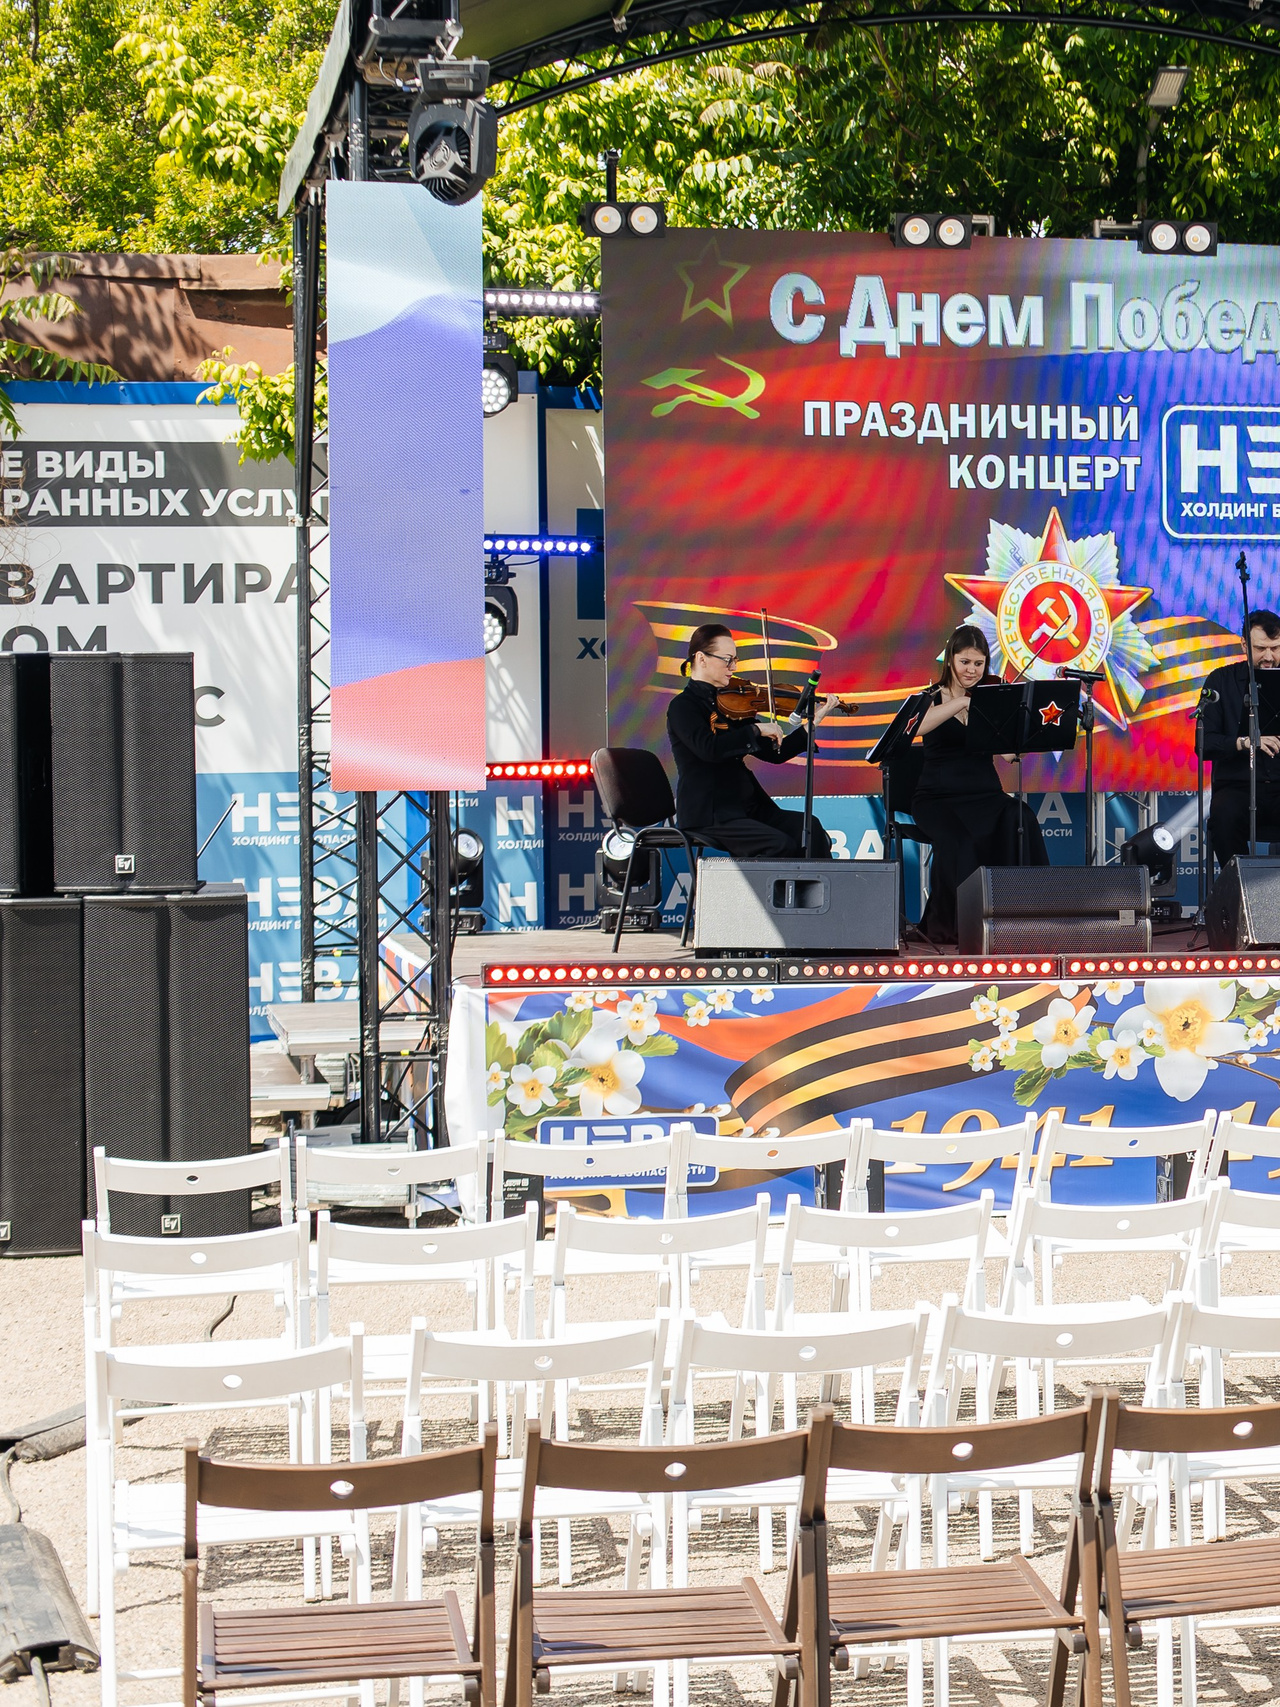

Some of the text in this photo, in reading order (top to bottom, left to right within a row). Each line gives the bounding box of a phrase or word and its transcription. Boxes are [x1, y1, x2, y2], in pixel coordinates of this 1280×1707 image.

[769, 271, 826, 344] С
[839, 274, 1045, 359] Днем
[803, 393, 1140, 445] ПРАЗДНИЧНЫЙ
[36, 450, 166, 484] ВИДЫ
[949, 453, 1142, 497] КОНЦЕРТ
[3, 488, 190, 517] РАННЫХ
[1181, 502, 1267, 520] ХОЛДИНГ
[232, 834, 291, 848] ХОЛДИНГ
[558, 832, 605, 843] ХОЛДИН
